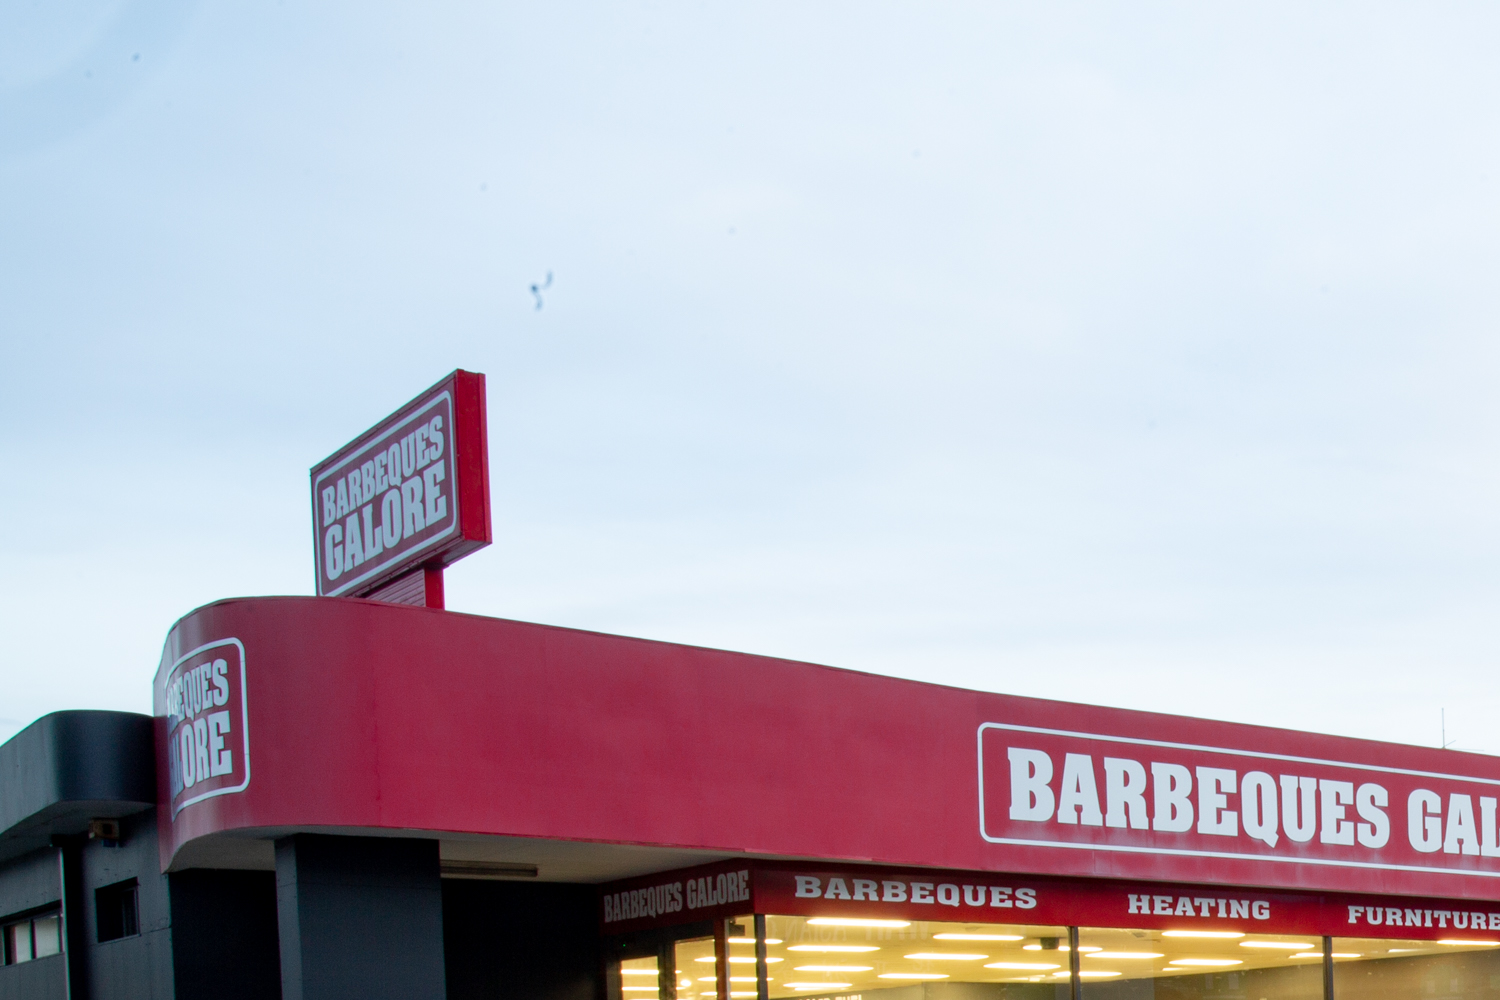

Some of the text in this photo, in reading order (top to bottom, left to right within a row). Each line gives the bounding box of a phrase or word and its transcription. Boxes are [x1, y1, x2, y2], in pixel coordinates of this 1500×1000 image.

[322, 415, 444, 527] BARBEQUES
[325, 459, 447, 580] GALORE
[1007, 747, 1391, 849] BARBEQUES
[603, 869, 750, 923] BARBEQUES GALORE
[794, 875, 1037, 909] BARBEQUES
[1127, 893, 1270, 920] HEATING
